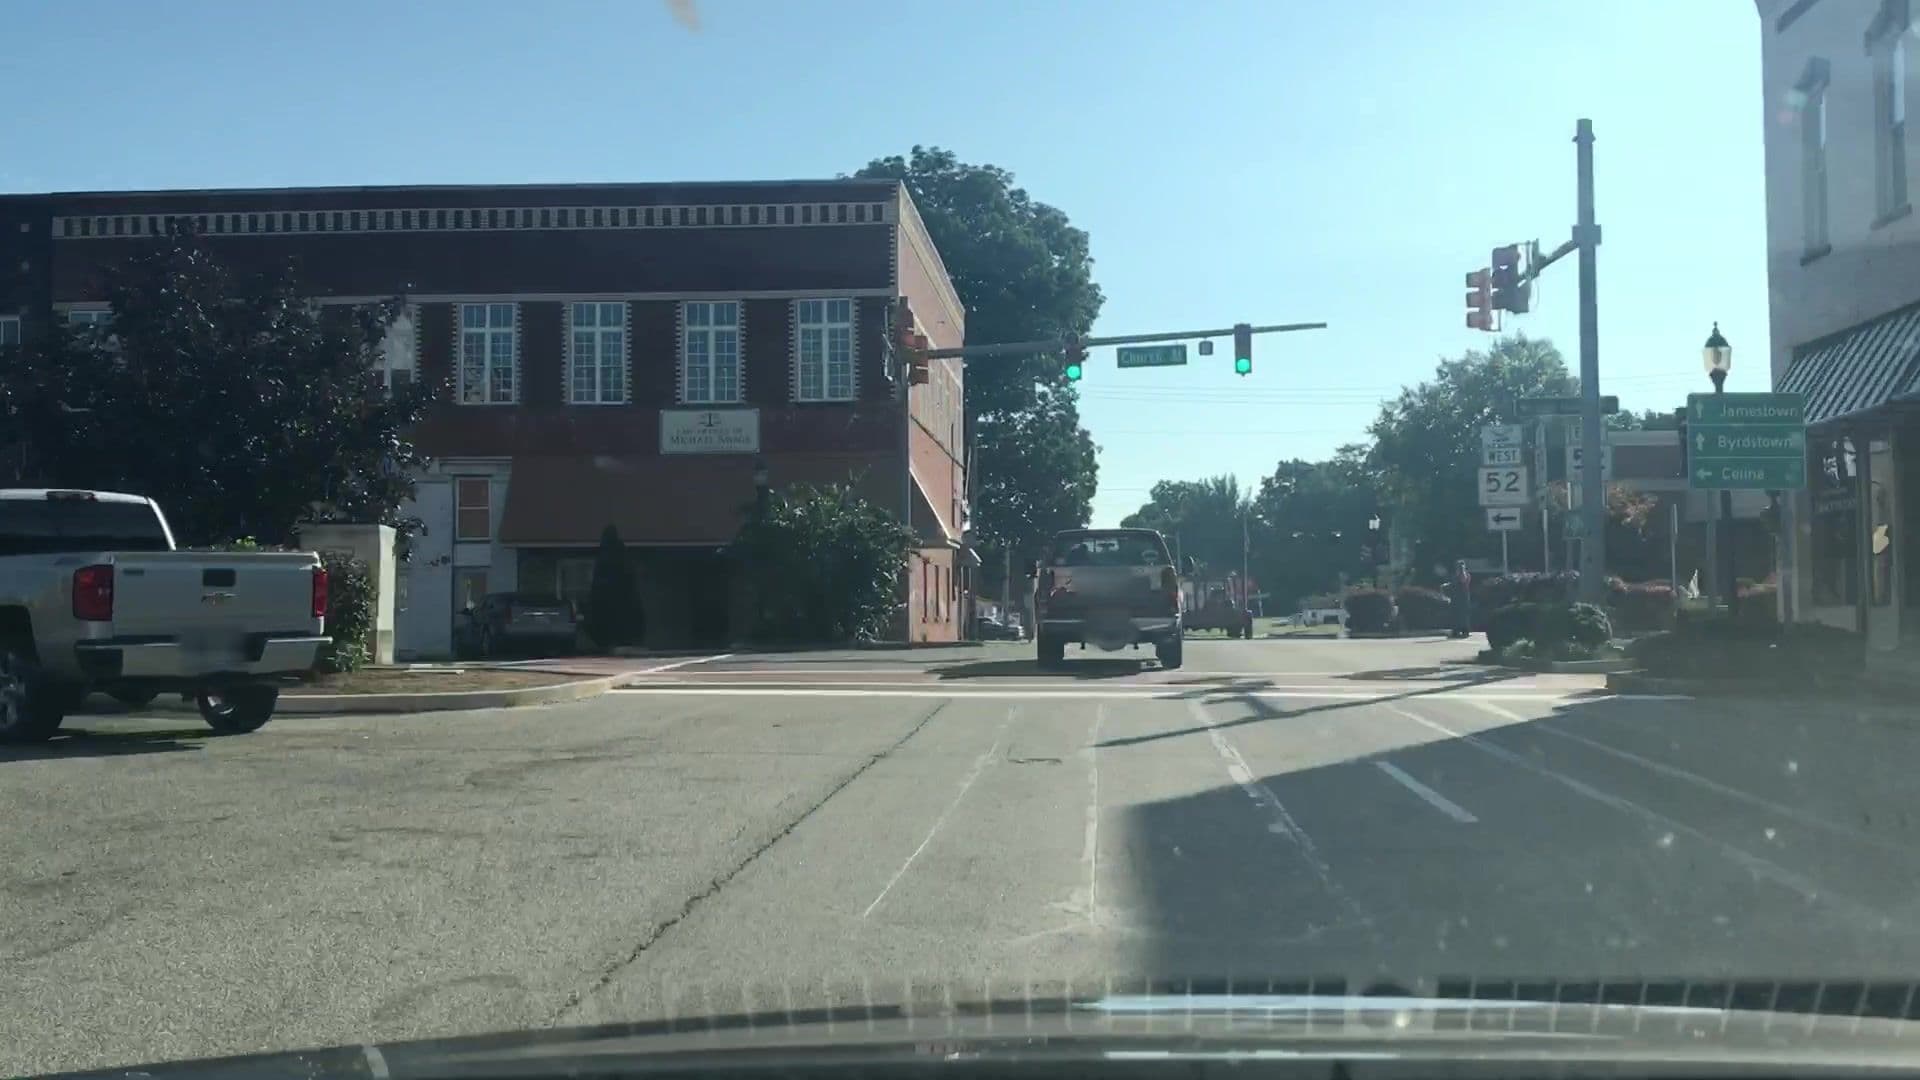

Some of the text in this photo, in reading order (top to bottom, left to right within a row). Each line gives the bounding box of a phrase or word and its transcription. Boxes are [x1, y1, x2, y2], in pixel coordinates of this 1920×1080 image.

[1720, 403, 1799, 417] Jamestown
[1718, 434, 1793, 452] Byrdstown
[1488, 450, 1517, 463] WEST
[1721, 466, 1765, 481] Celina
[1486, 471, 1520, 493] 52
